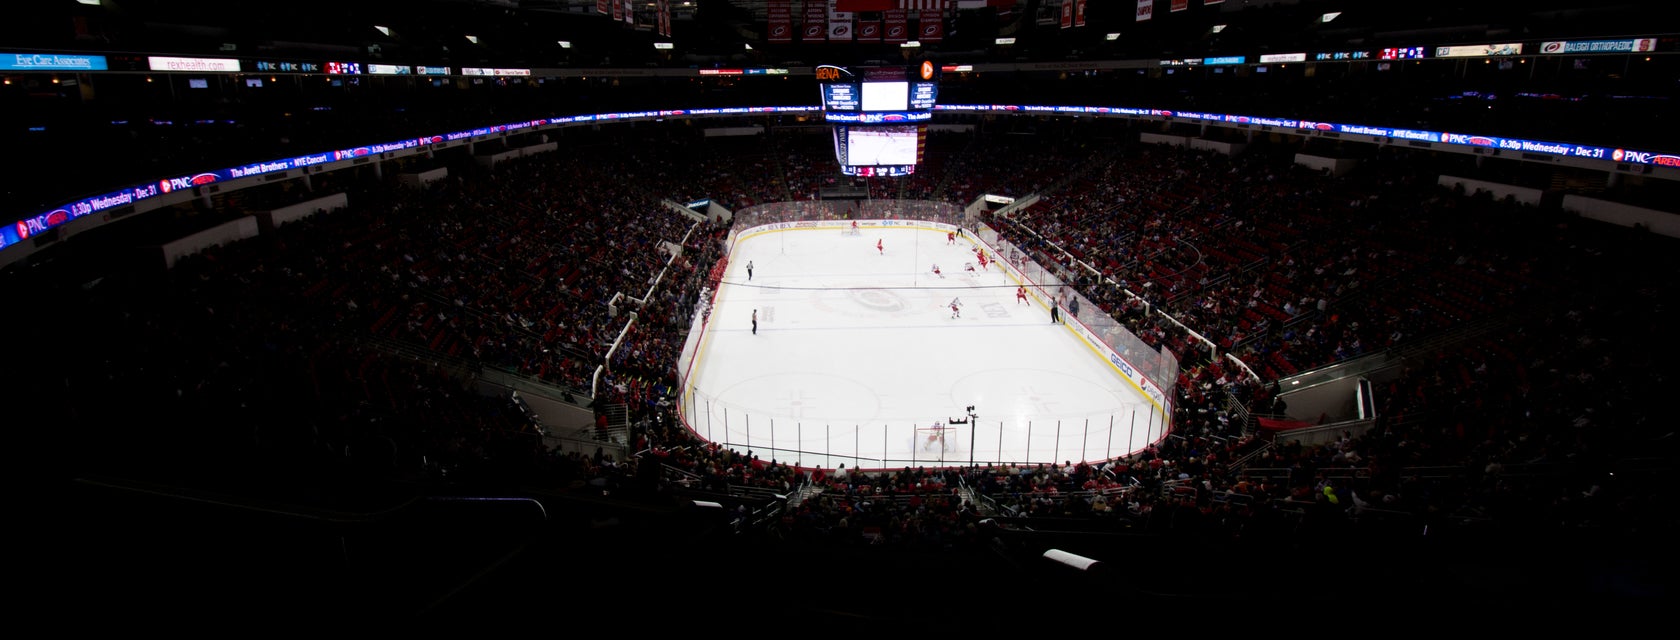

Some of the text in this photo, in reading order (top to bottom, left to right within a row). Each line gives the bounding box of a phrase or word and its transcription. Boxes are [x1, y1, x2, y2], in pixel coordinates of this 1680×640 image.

[1566, 42, 1589, 52] RALEIGH
[33, 54, 52, 66] Care
[54, 56, 91, 66] Associates
[168, 60, 224, 70] rexhealth.com
[1363, 128, 1387, 136] Brothers
[1405, 131, 1429, 140] Concert
[1450, 134, 1468, 144] PNC
[1500, 140, 1604, 158] 8:30p Wednesday Dec 31
[1624, 151, 1680, 166] PNC AREN
[230, 154, 327, 178] The Avett Brothers NYE Concert
[170, 178, 192, 190] PNC
[72, 185, 158, 218] 8:30p Wednesday Dec 31
[27, 216, 48, 234] PNC
[1110, 353, 1132, 378] GEICO
